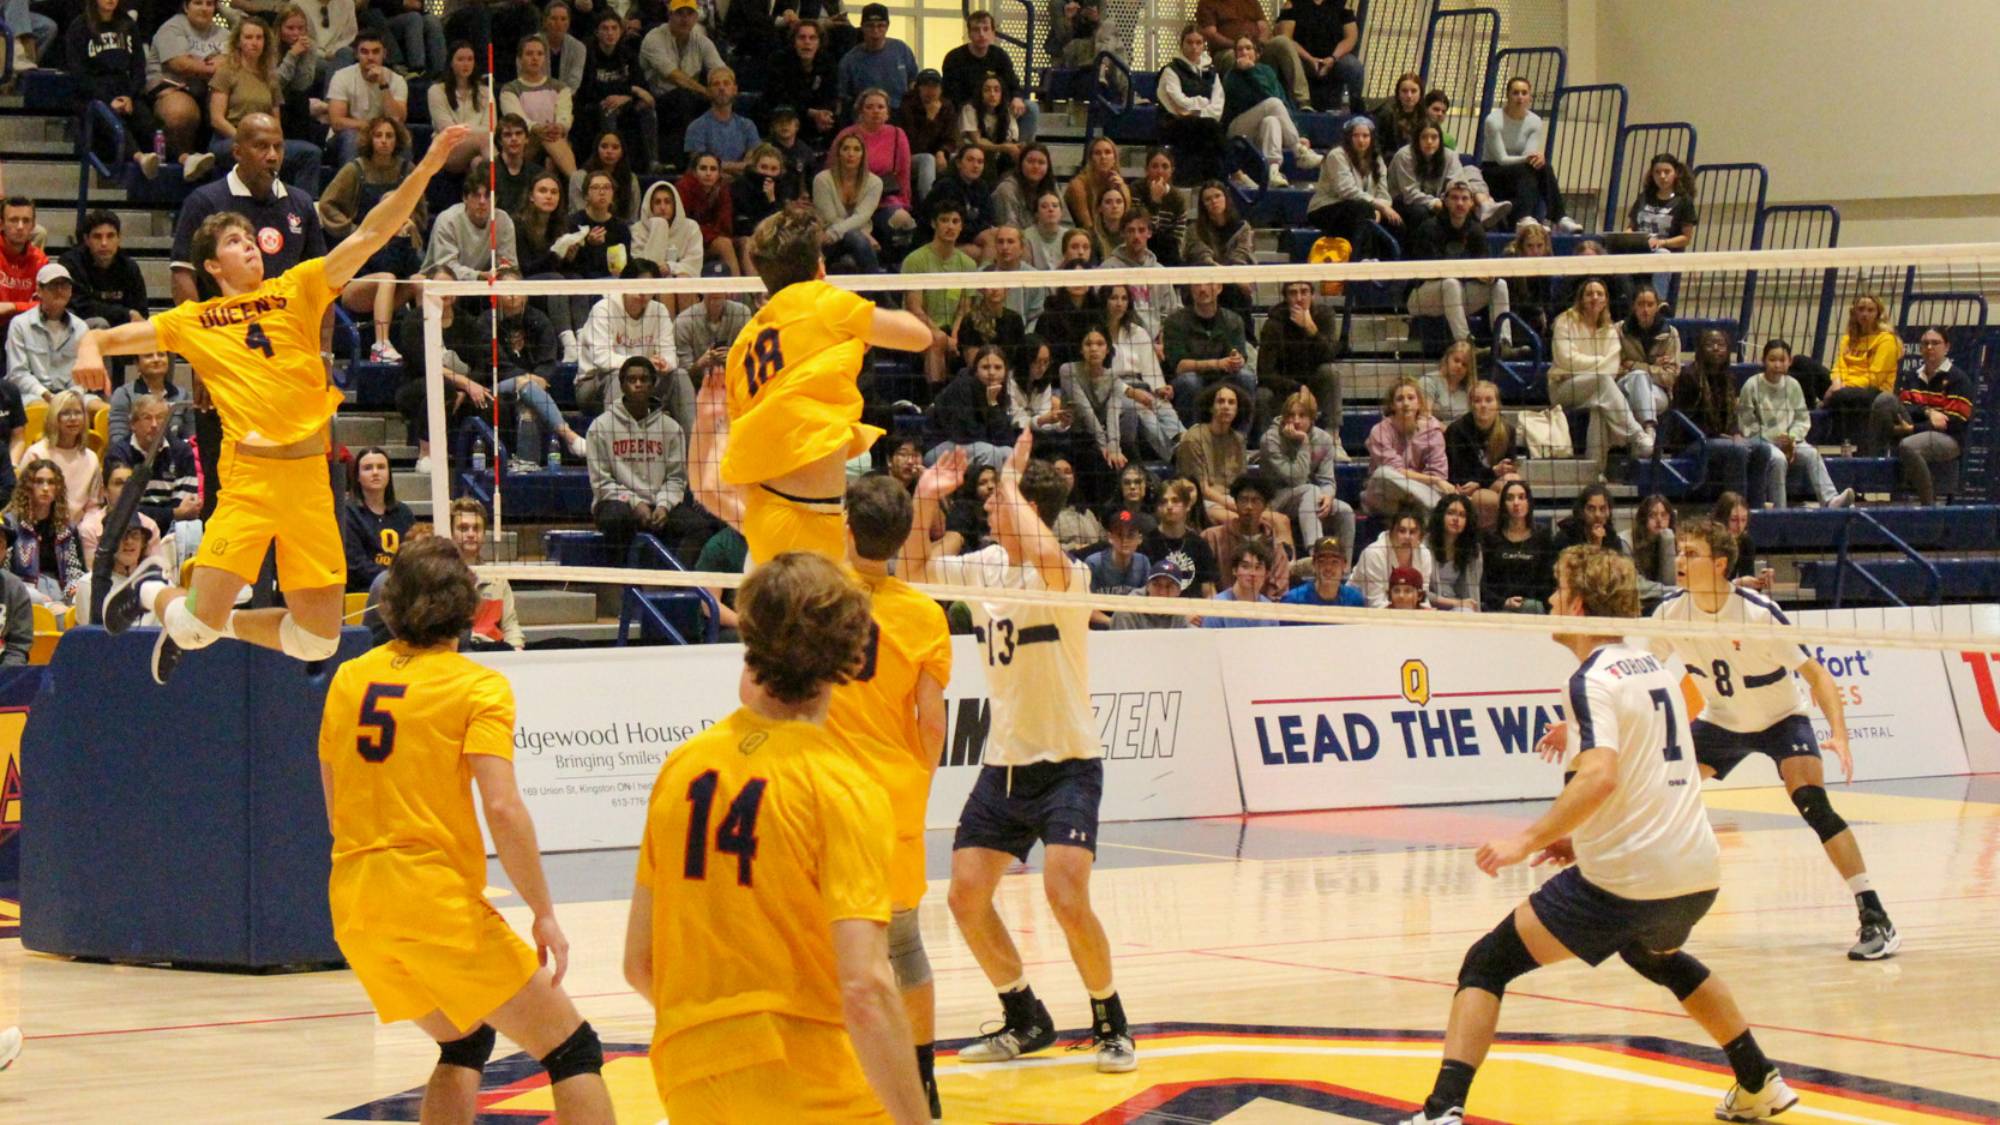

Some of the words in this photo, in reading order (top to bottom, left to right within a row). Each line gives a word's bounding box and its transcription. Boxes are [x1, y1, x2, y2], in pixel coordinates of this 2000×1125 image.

[244, 321, 275, 359] 4
[743, 326, 785, 398] 18
[612, 439, 664, 455] QUEEN'S
[986, 618, 1015, 667] 13
[1805, 646, 1870, 678] fort
[1400, 658, 1430, 707] Q
[1604, 655, 1663, 680] TORON
[1712, 659, 1735, 698] 8
[356, 681, 409, 763] 5
[514, 722, 619, 756] dgewood
[626, 722, 695, 744] House
[1090, 690, 1182, 760] ZEN
[1254, 713, 1380, 766] LEAD
[1391, 708, 1481, 759] THE
[1648, 688, 1683, 762] 7
[1848, 726, 1895, 740] ENTRAL
[556, 754, 615, 772] Bringing
[619, 750, 662, 768] Smiles
[540, 785, 565, 796] Union
[580, 782, 617, 795] Kingston
[684, 768, 768, 889] 14
